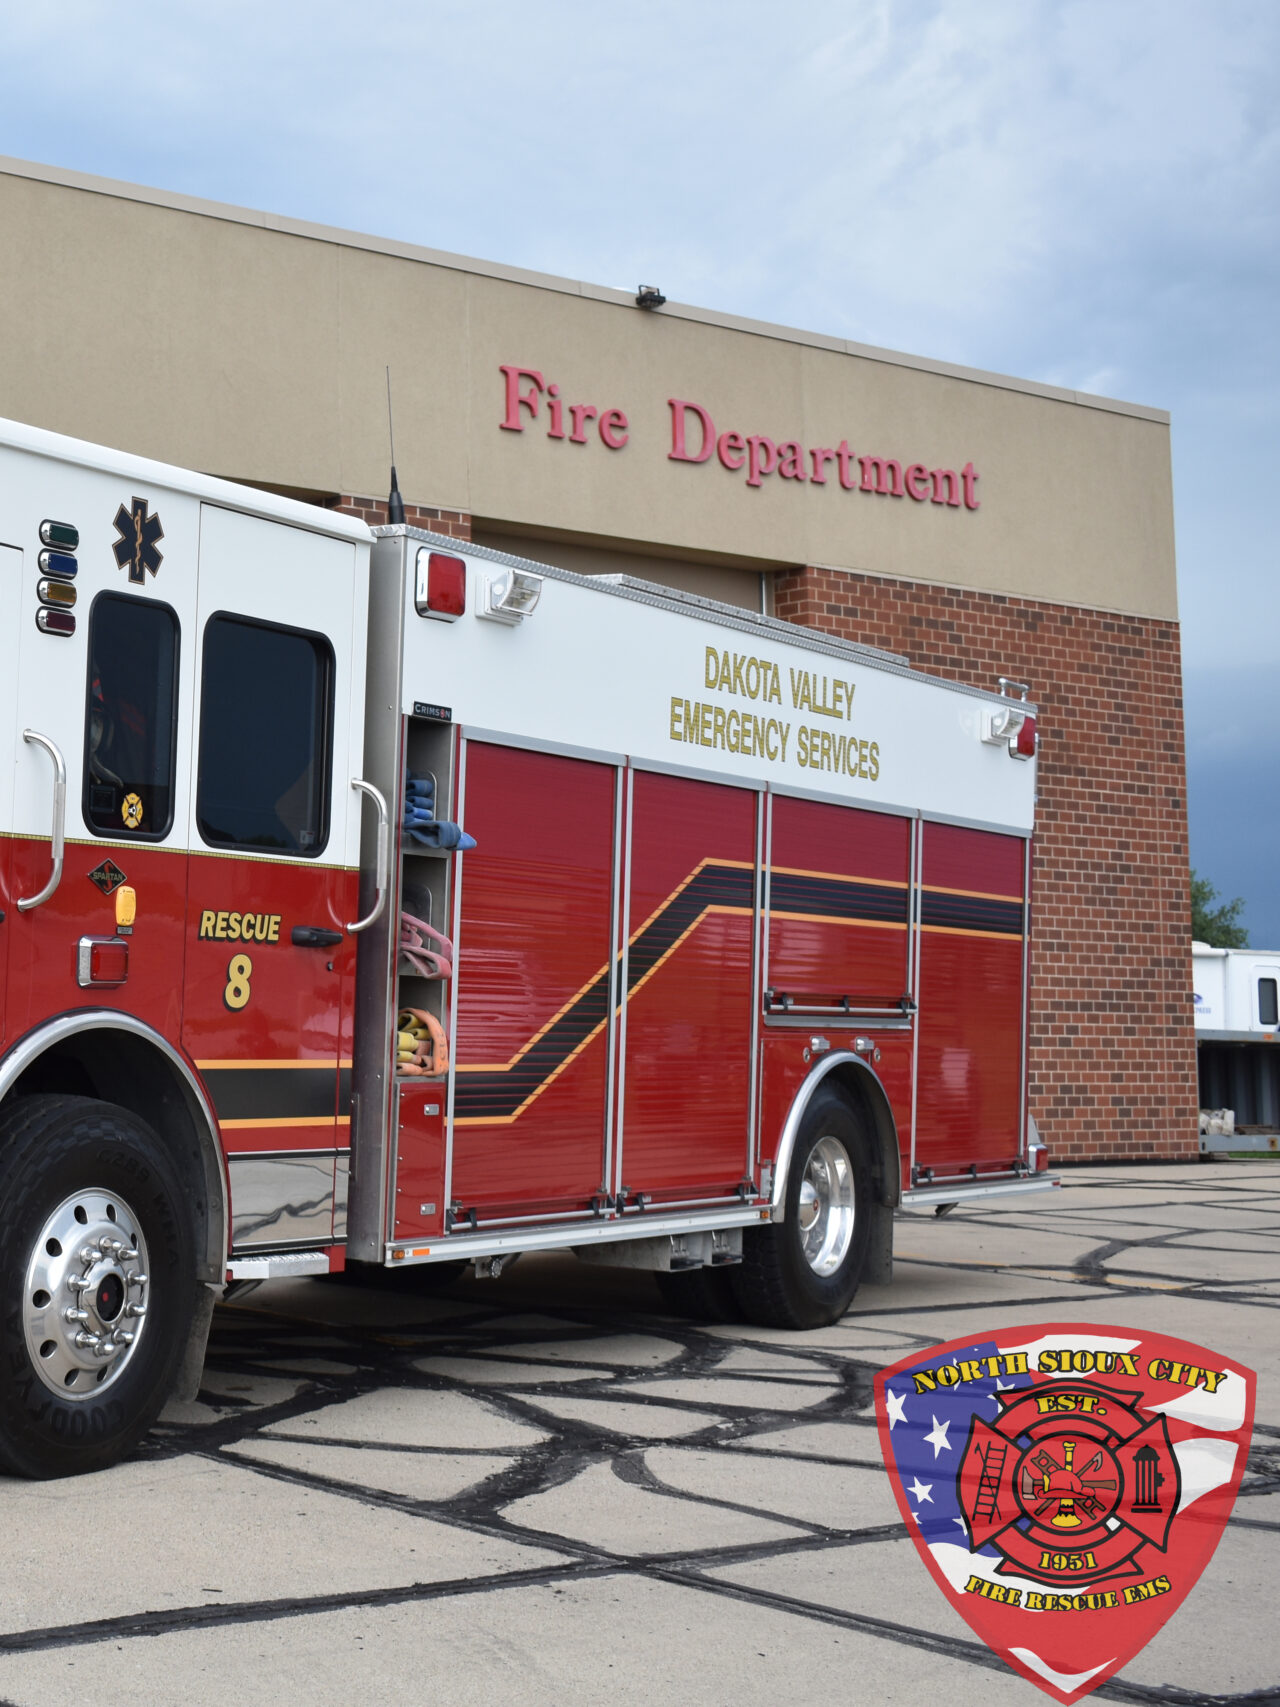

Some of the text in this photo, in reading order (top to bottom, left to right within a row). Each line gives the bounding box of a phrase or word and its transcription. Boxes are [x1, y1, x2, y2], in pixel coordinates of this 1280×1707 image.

[499, 365, 981, 510] Fire Department
[704, 646, 856, 721] DAKOTA VALLEY
[670, 696, 880, 782] EMERGENCY SERVICES
[92, 871, 123, 881] SPARTAN
[199, 910, 282, 944] RESCUE
[224, 953, 253, 1011] 8
